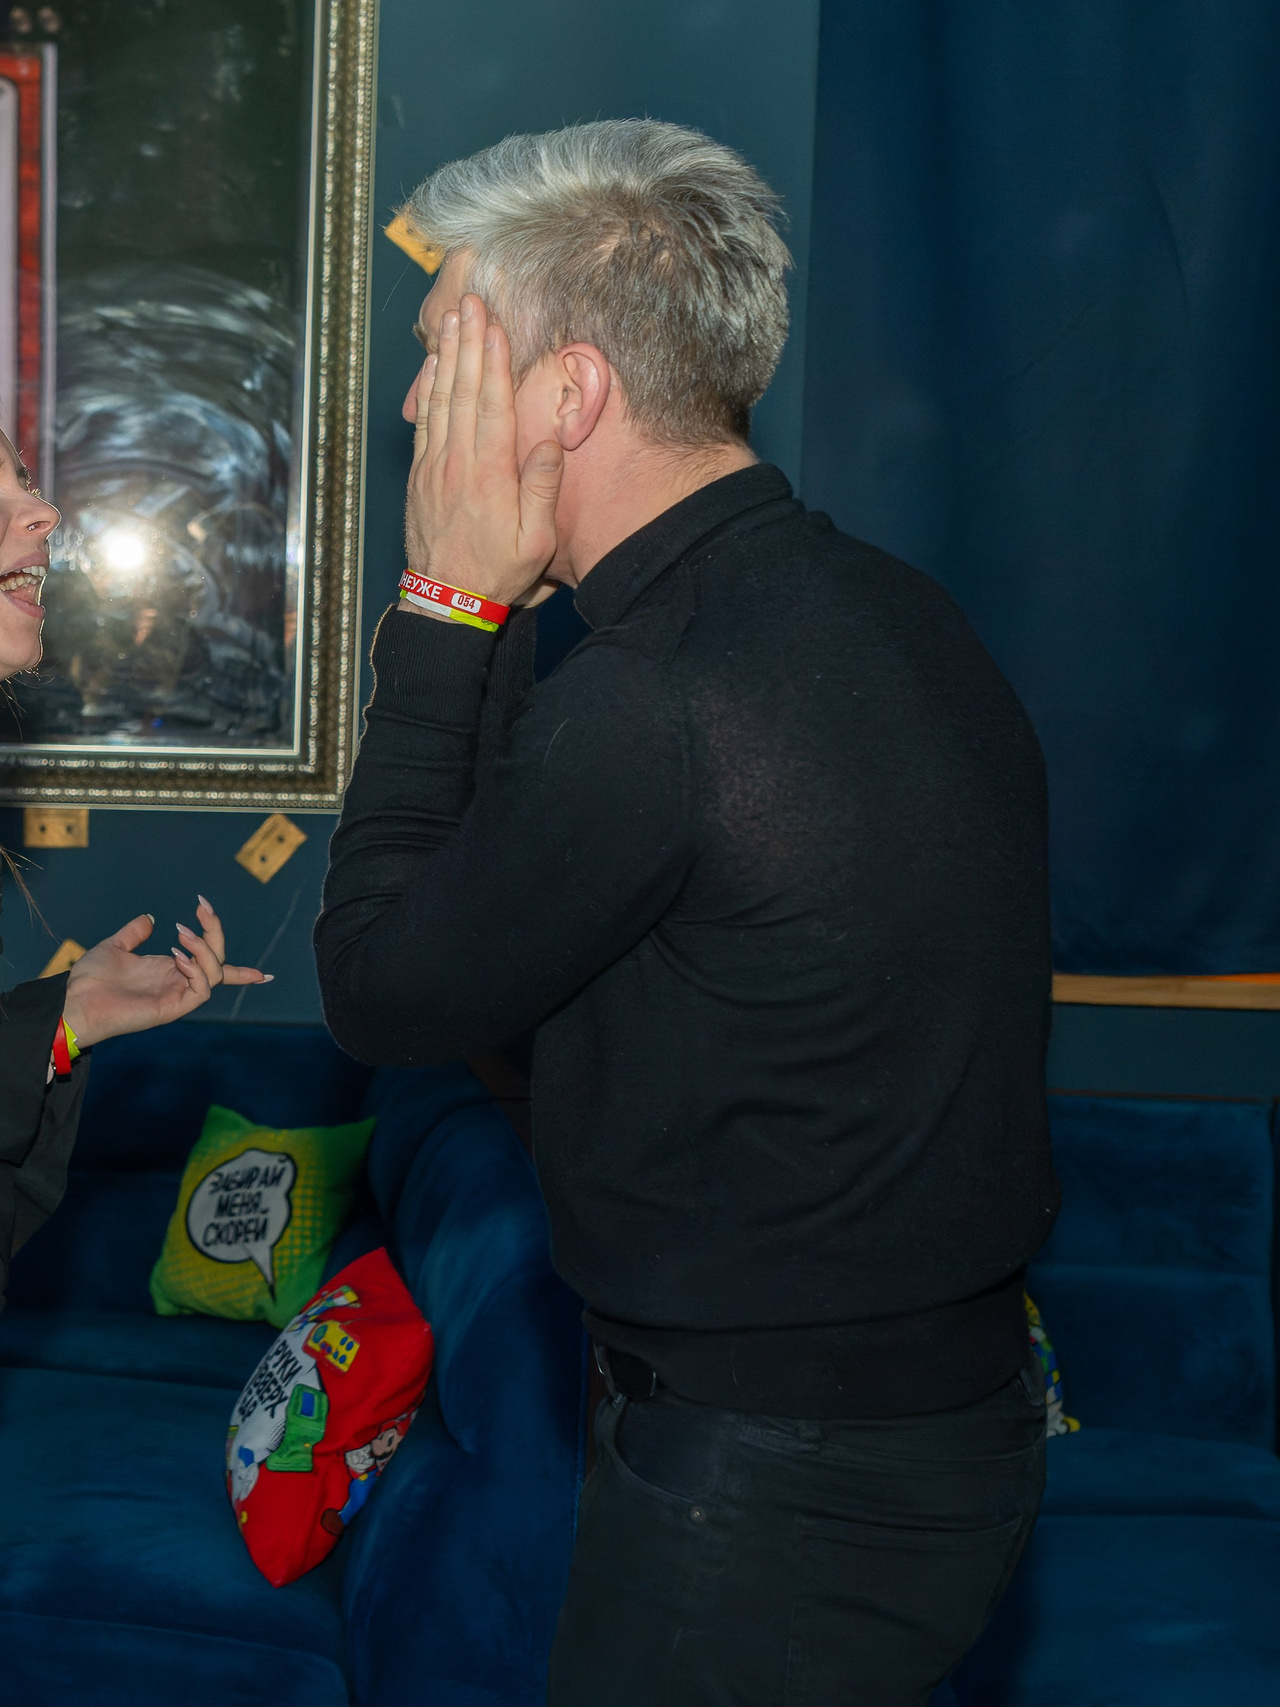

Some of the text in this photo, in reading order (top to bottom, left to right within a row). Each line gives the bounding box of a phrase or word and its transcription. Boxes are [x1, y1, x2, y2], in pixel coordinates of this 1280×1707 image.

[457, 594, 476, 610] 054
[208, 1158, 287, 1194] ЗАБИРАЙ
[214, 1191, 262, 1218] МЕНЯ
[202, 1207, 269, 1247] СКОРЕЙ
[264, 1338, 303, 1388] РУКИ
